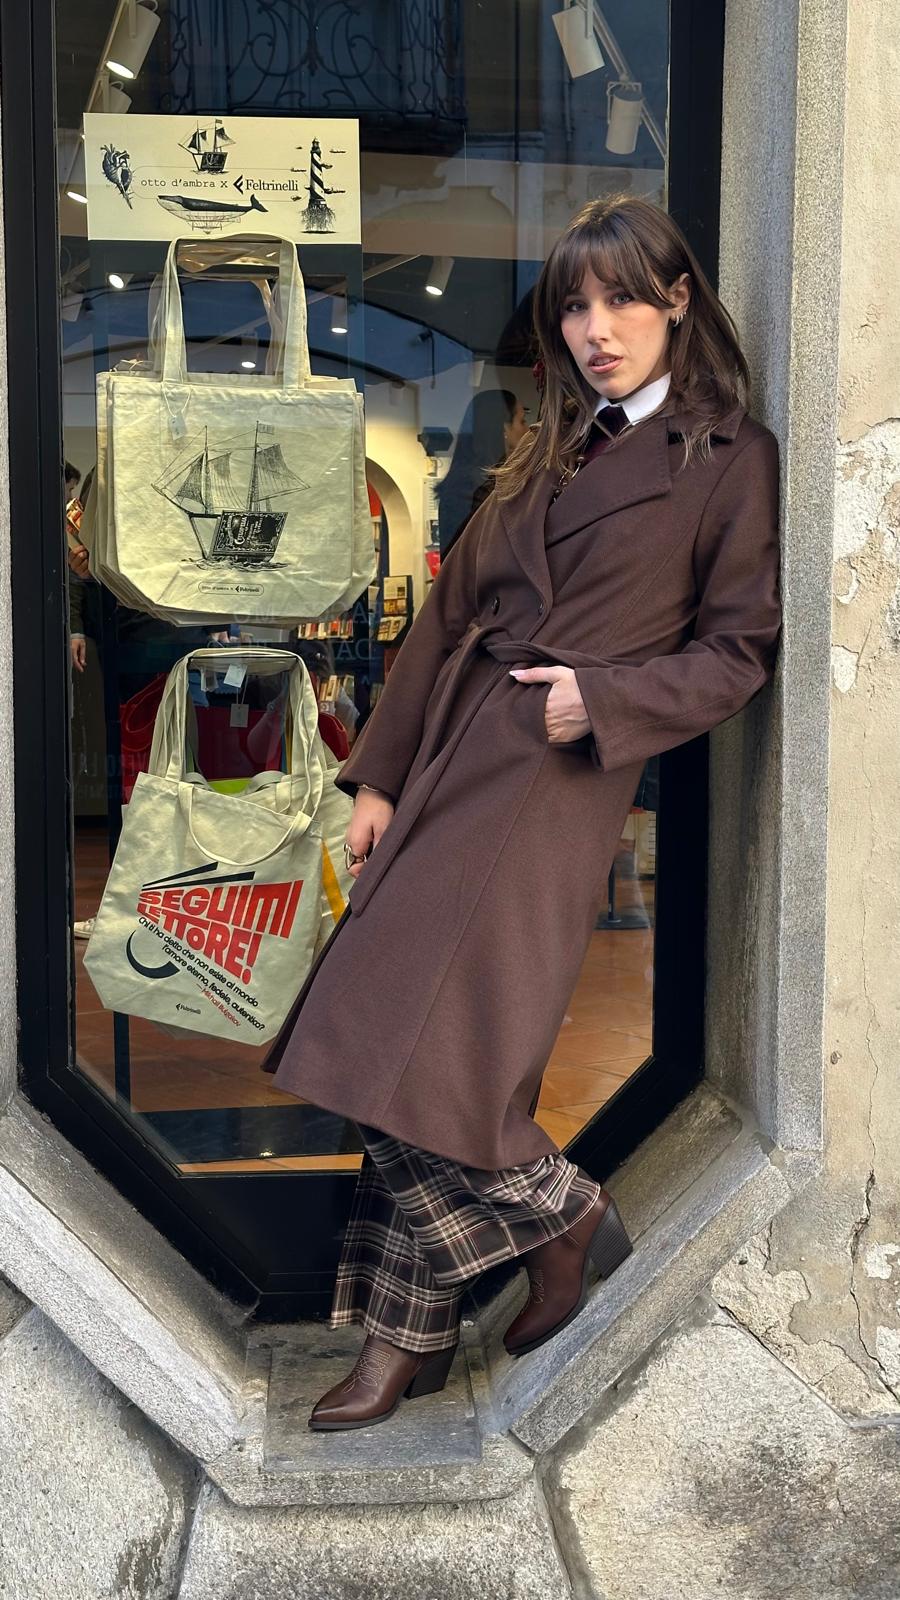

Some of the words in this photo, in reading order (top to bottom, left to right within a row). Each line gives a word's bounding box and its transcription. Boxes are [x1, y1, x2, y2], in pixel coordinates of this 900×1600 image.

[140, 179, 167, 187] otto
[171, 178, 216, 188] d'ambra
[245, 179, 298, 191] Feltrinelli
[136, 903, 263, 985] LETTORE!
[138, 880, 304, 939] SEGUIMI
[153, 927, 165, 939] ha
[164, 936, 183, 952] detto
[182, 949, 195, 961] che
[194, 958, 210, 972] non
[208, 968, 227, 983] esiste
[226, 982, 236, 990] al
[233, 986, 259, 1007] mondo
[162, 944, 188, 967] l'amore
[186, 965, 209, 987] eterno,
[209, 982, 231, 1005] fedele,
[231, 1002, 266, 1031] autentico?
